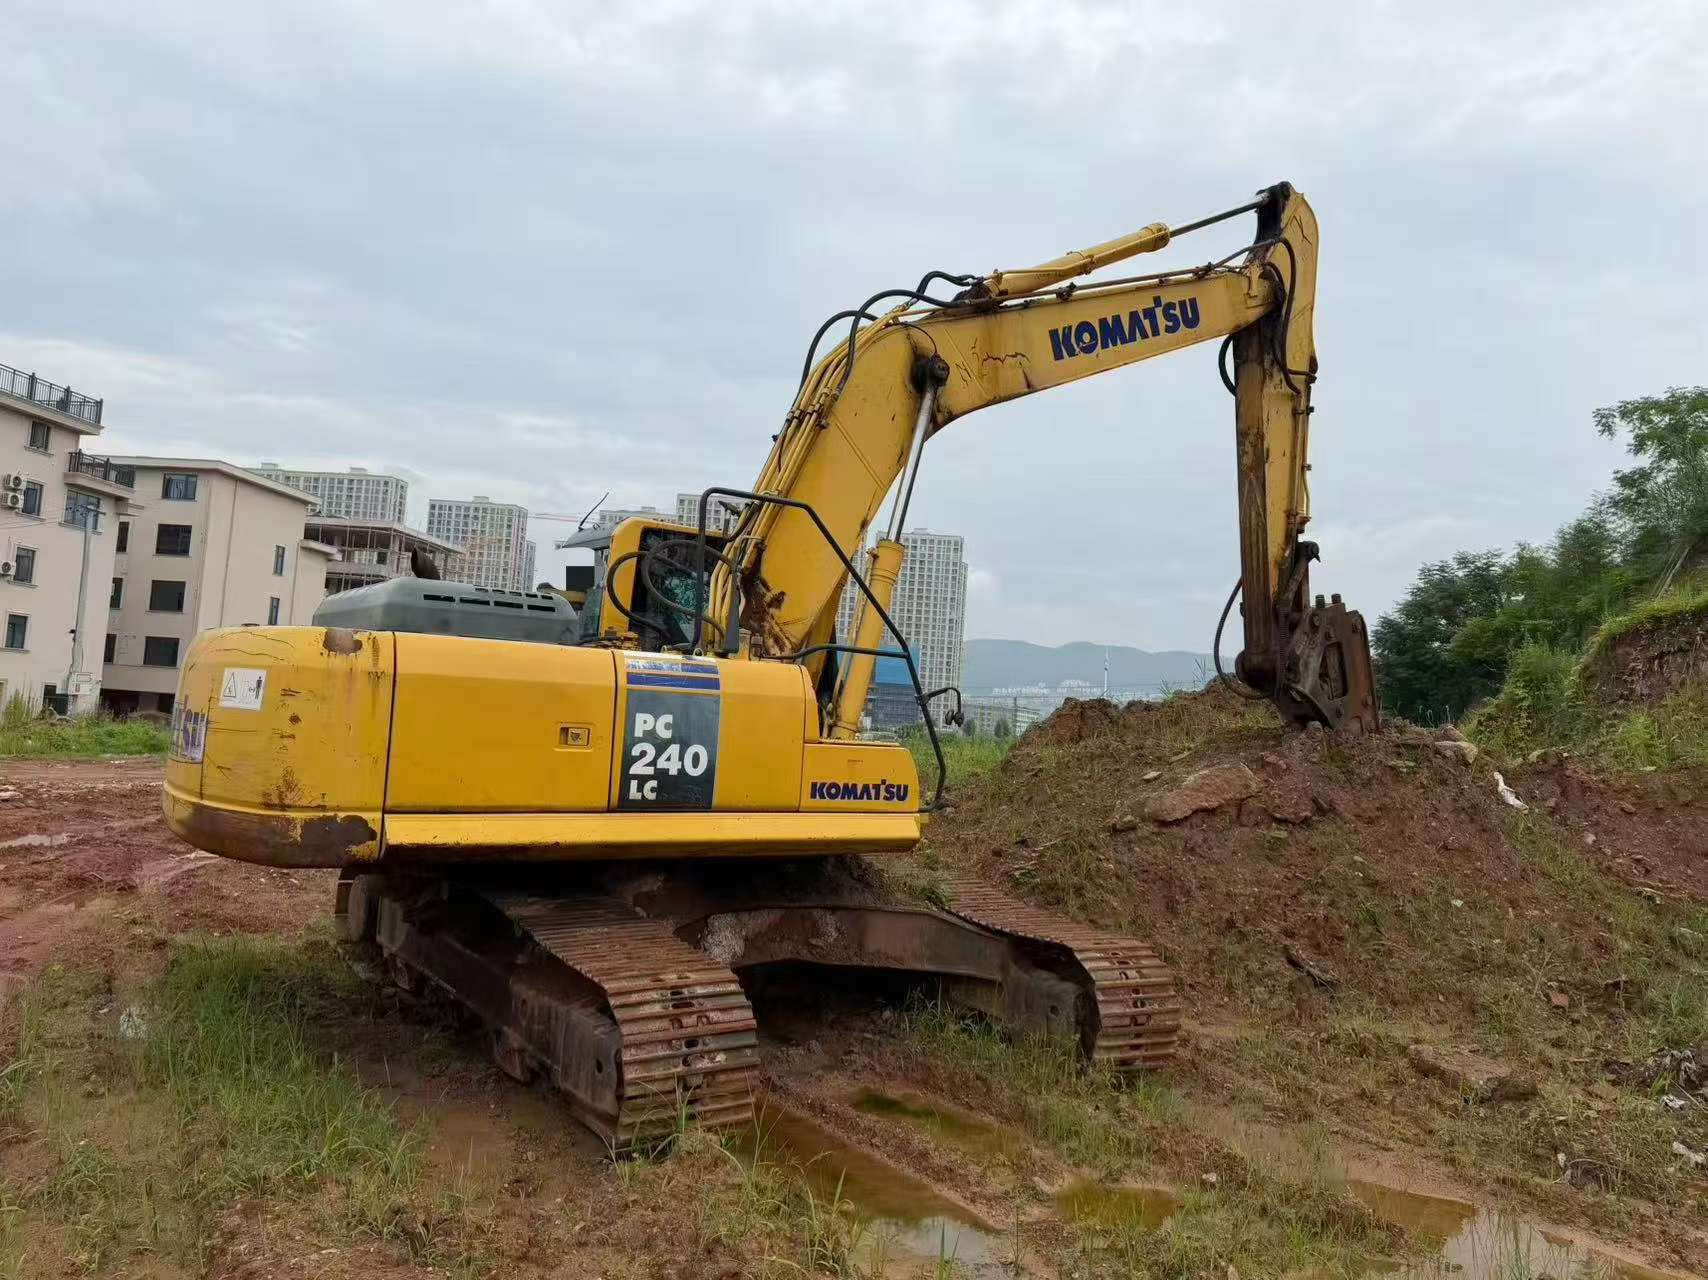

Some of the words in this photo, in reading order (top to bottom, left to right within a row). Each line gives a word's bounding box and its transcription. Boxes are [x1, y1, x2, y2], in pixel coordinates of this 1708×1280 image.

[1049, 295, 1200, 361] KOMATSU
[634, 713, 673, 738] PC
[629, 743, 708, 776] 240
[628, 780, 657, 800] LC
[810, 779, 908, 802] KOMATSU
